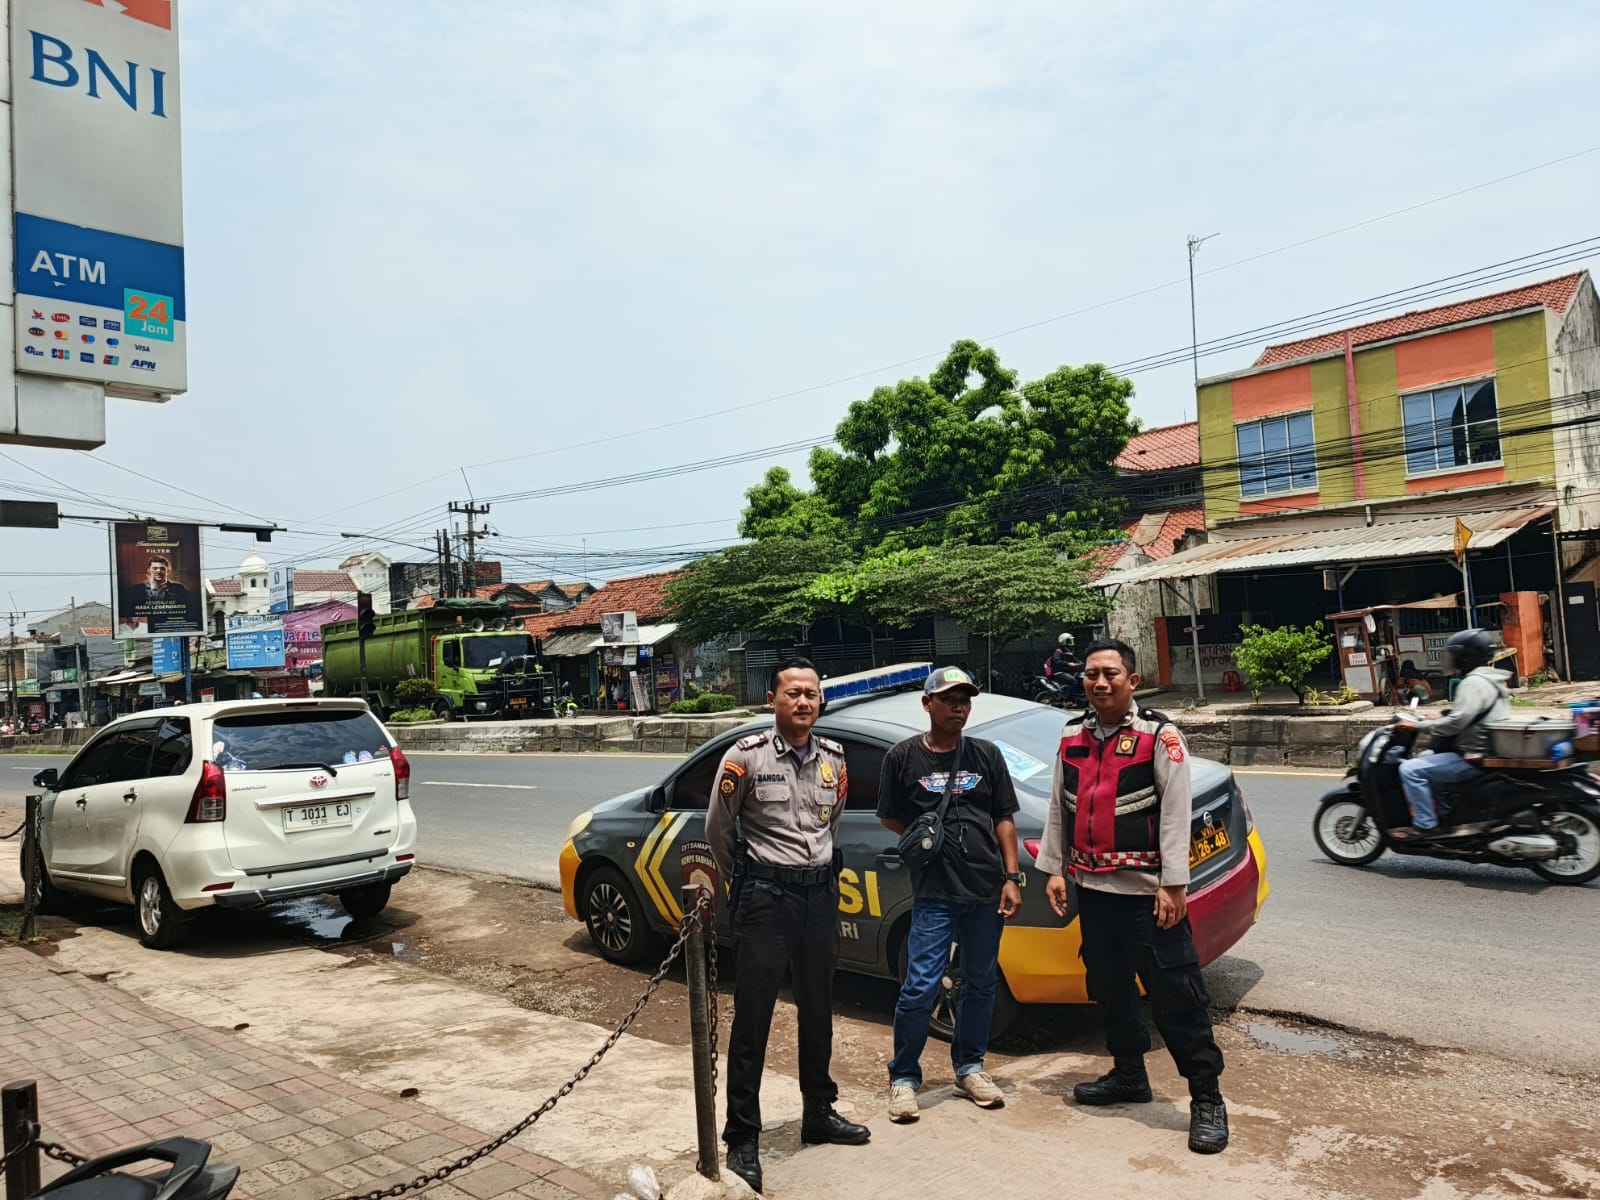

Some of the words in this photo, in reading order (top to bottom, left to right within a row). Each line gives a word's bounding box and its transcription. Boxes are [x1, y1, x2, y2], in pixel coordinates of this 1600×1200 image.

[28, 29, 168, 119] BNI
[30, 250, 106, 285] ATM
[128, 295, 169, 324] 24
[140, 320, 168, 336] Jam
[134, 343, 151, 353] VISA
[131, 359, 156, 369] APN
[1186, 645, 1232, 660] PNITIPAN
[286, 810, 294, 822] T
[301, 806, 327, 820] 1011
[336, 804, 349, 817] EJ
[838, 868, 882, 917] SI
